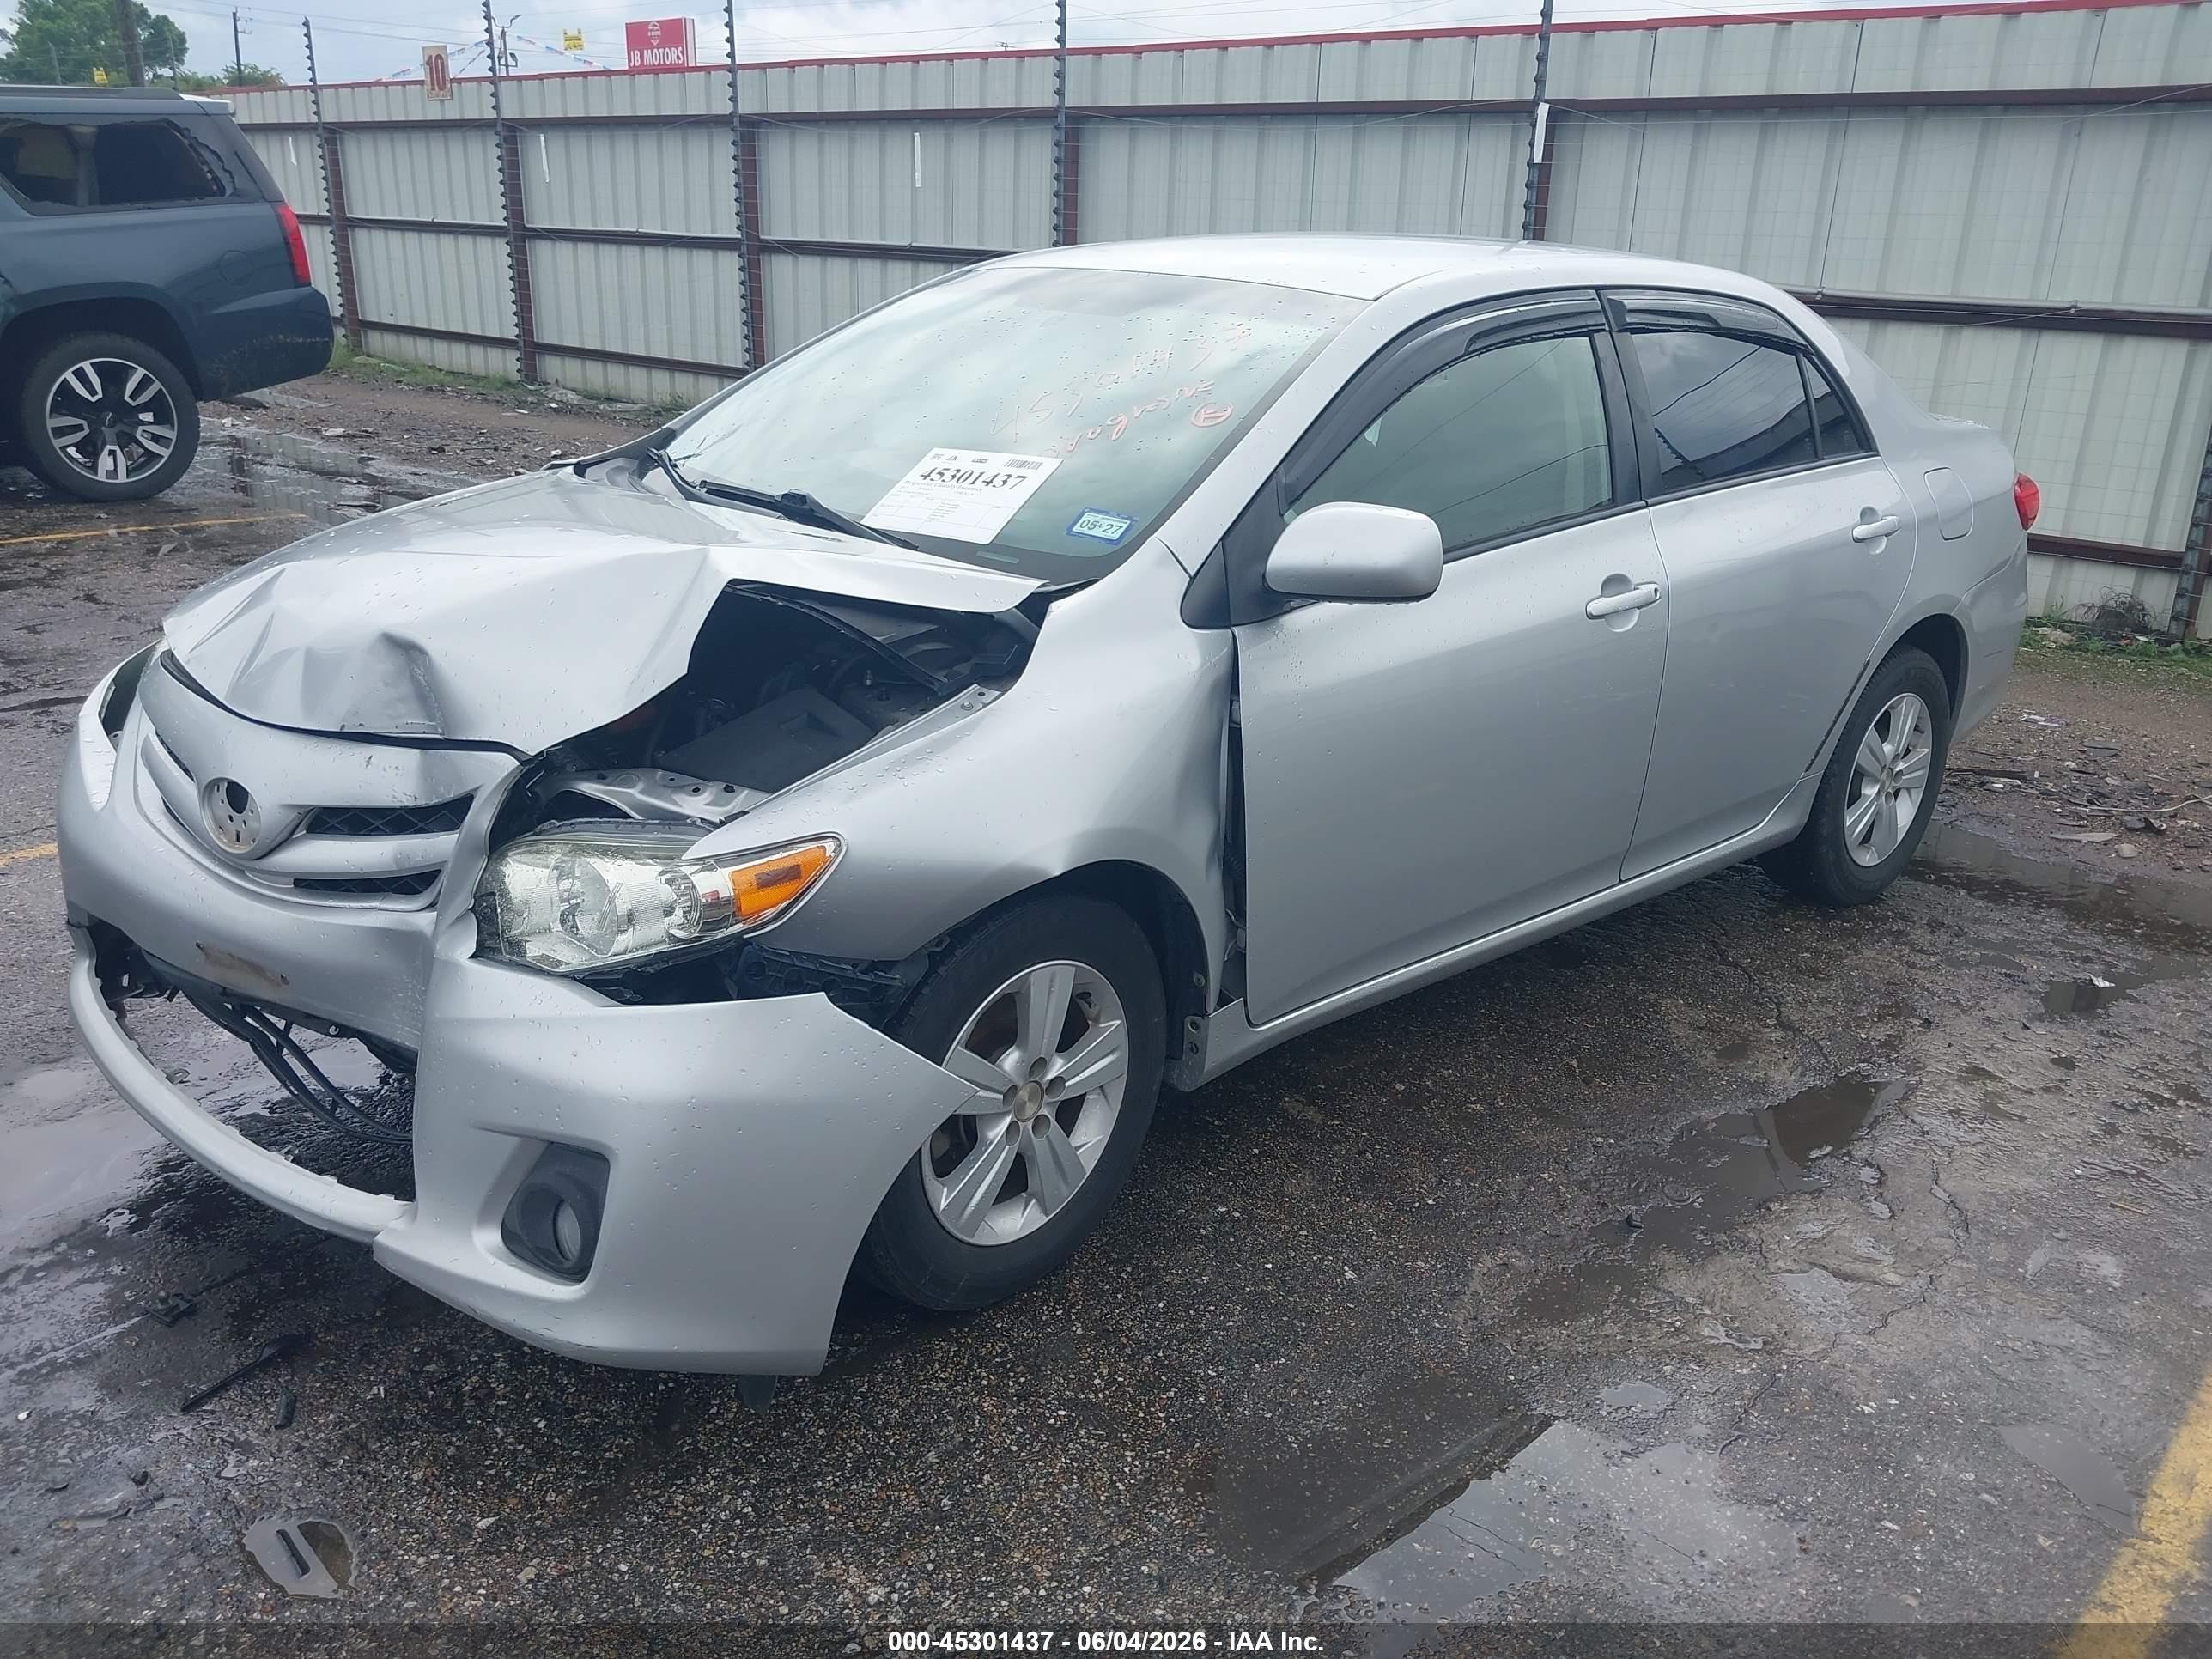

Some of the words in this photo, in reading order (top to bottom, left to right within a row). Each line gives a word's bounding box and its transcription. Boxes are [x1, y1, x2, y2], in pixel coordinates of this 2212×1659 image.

[629, 50, 641, 67] JB
[643, 46, 684, 66] MOTORS
[425, 53, 447, 91] 10
[919, 466, 1029, 490] 45301437
